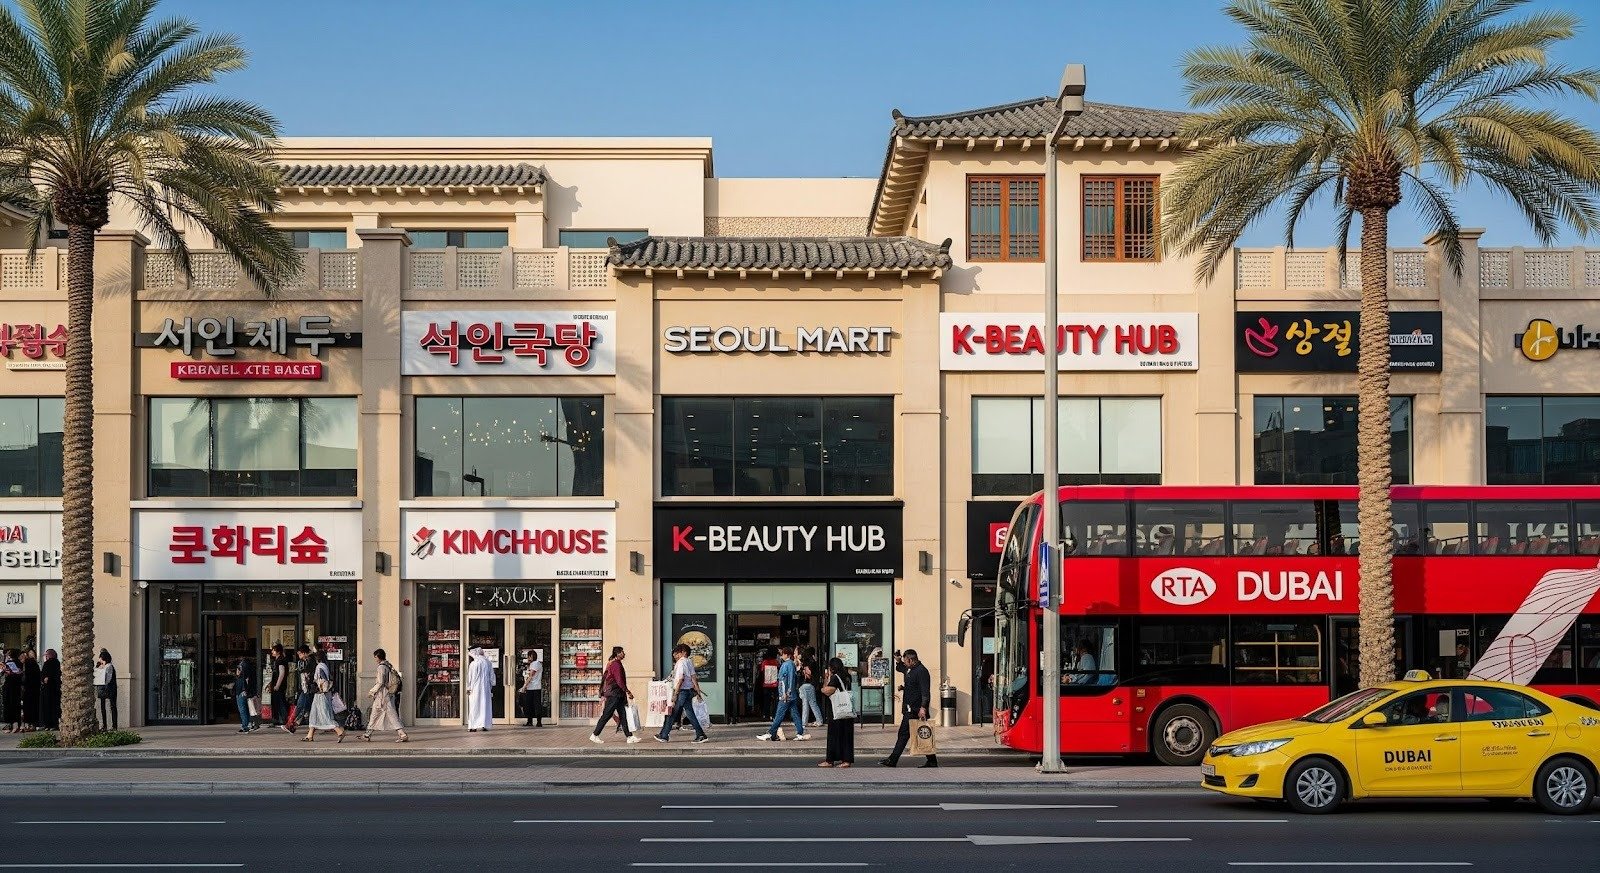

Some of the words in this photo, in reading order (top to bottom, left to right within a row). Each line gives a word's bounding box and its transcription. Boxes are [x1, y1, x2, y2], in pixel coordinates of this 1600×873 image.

[664, 326, 790, 353] SEOUL
[796, 326, 893, 353] MART
[1114, 324, 1180, 355] HUB
[672, 525, 818, 552] K-BEAUTY
[826, 525, 886, 552] HUB
[1161, 576, 1209, 597] RTA
[1237, 571, 1343, 601] DUBAI
[1384, 749, 1432, 763] DUBAI
